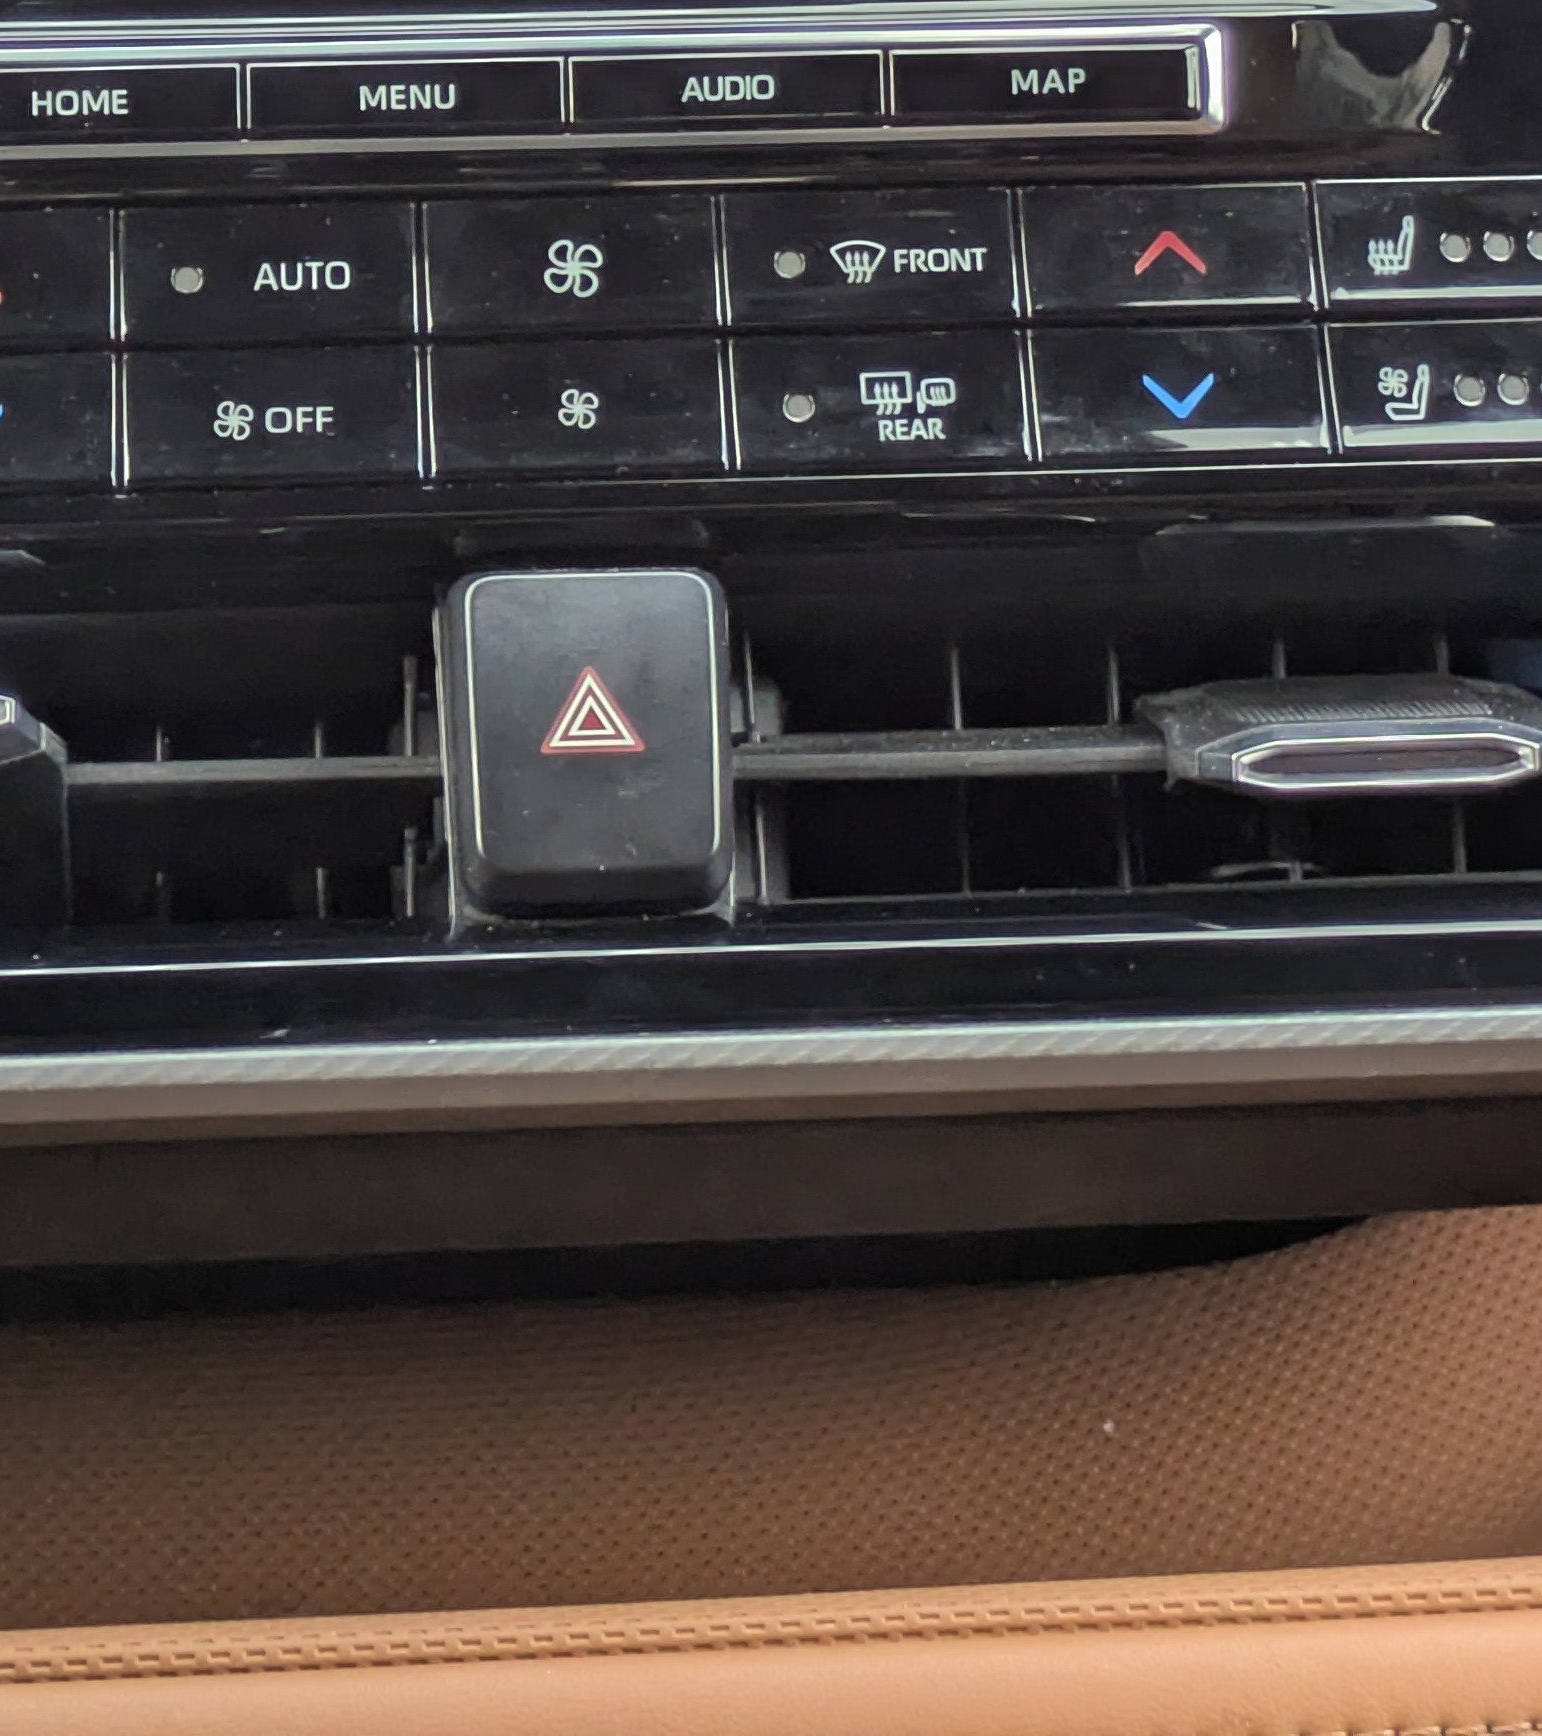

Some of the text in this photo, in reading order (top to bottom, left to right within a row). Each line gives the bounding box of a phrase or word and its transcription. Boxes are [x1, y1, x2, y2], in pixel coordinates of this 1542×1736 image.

[681, 75, 775, 102] AUDIO
[1011, 68, 1087, 95] MAP
[31, 90, 129, 116] HOME
[358, 84, 456, 111] MENU
[893, 247, 987, 274] FRONT
[254, 262, 351, 291] AUTO
[264, 406, 334, 435] OFF
[879, 419, 947, 442] REAR
